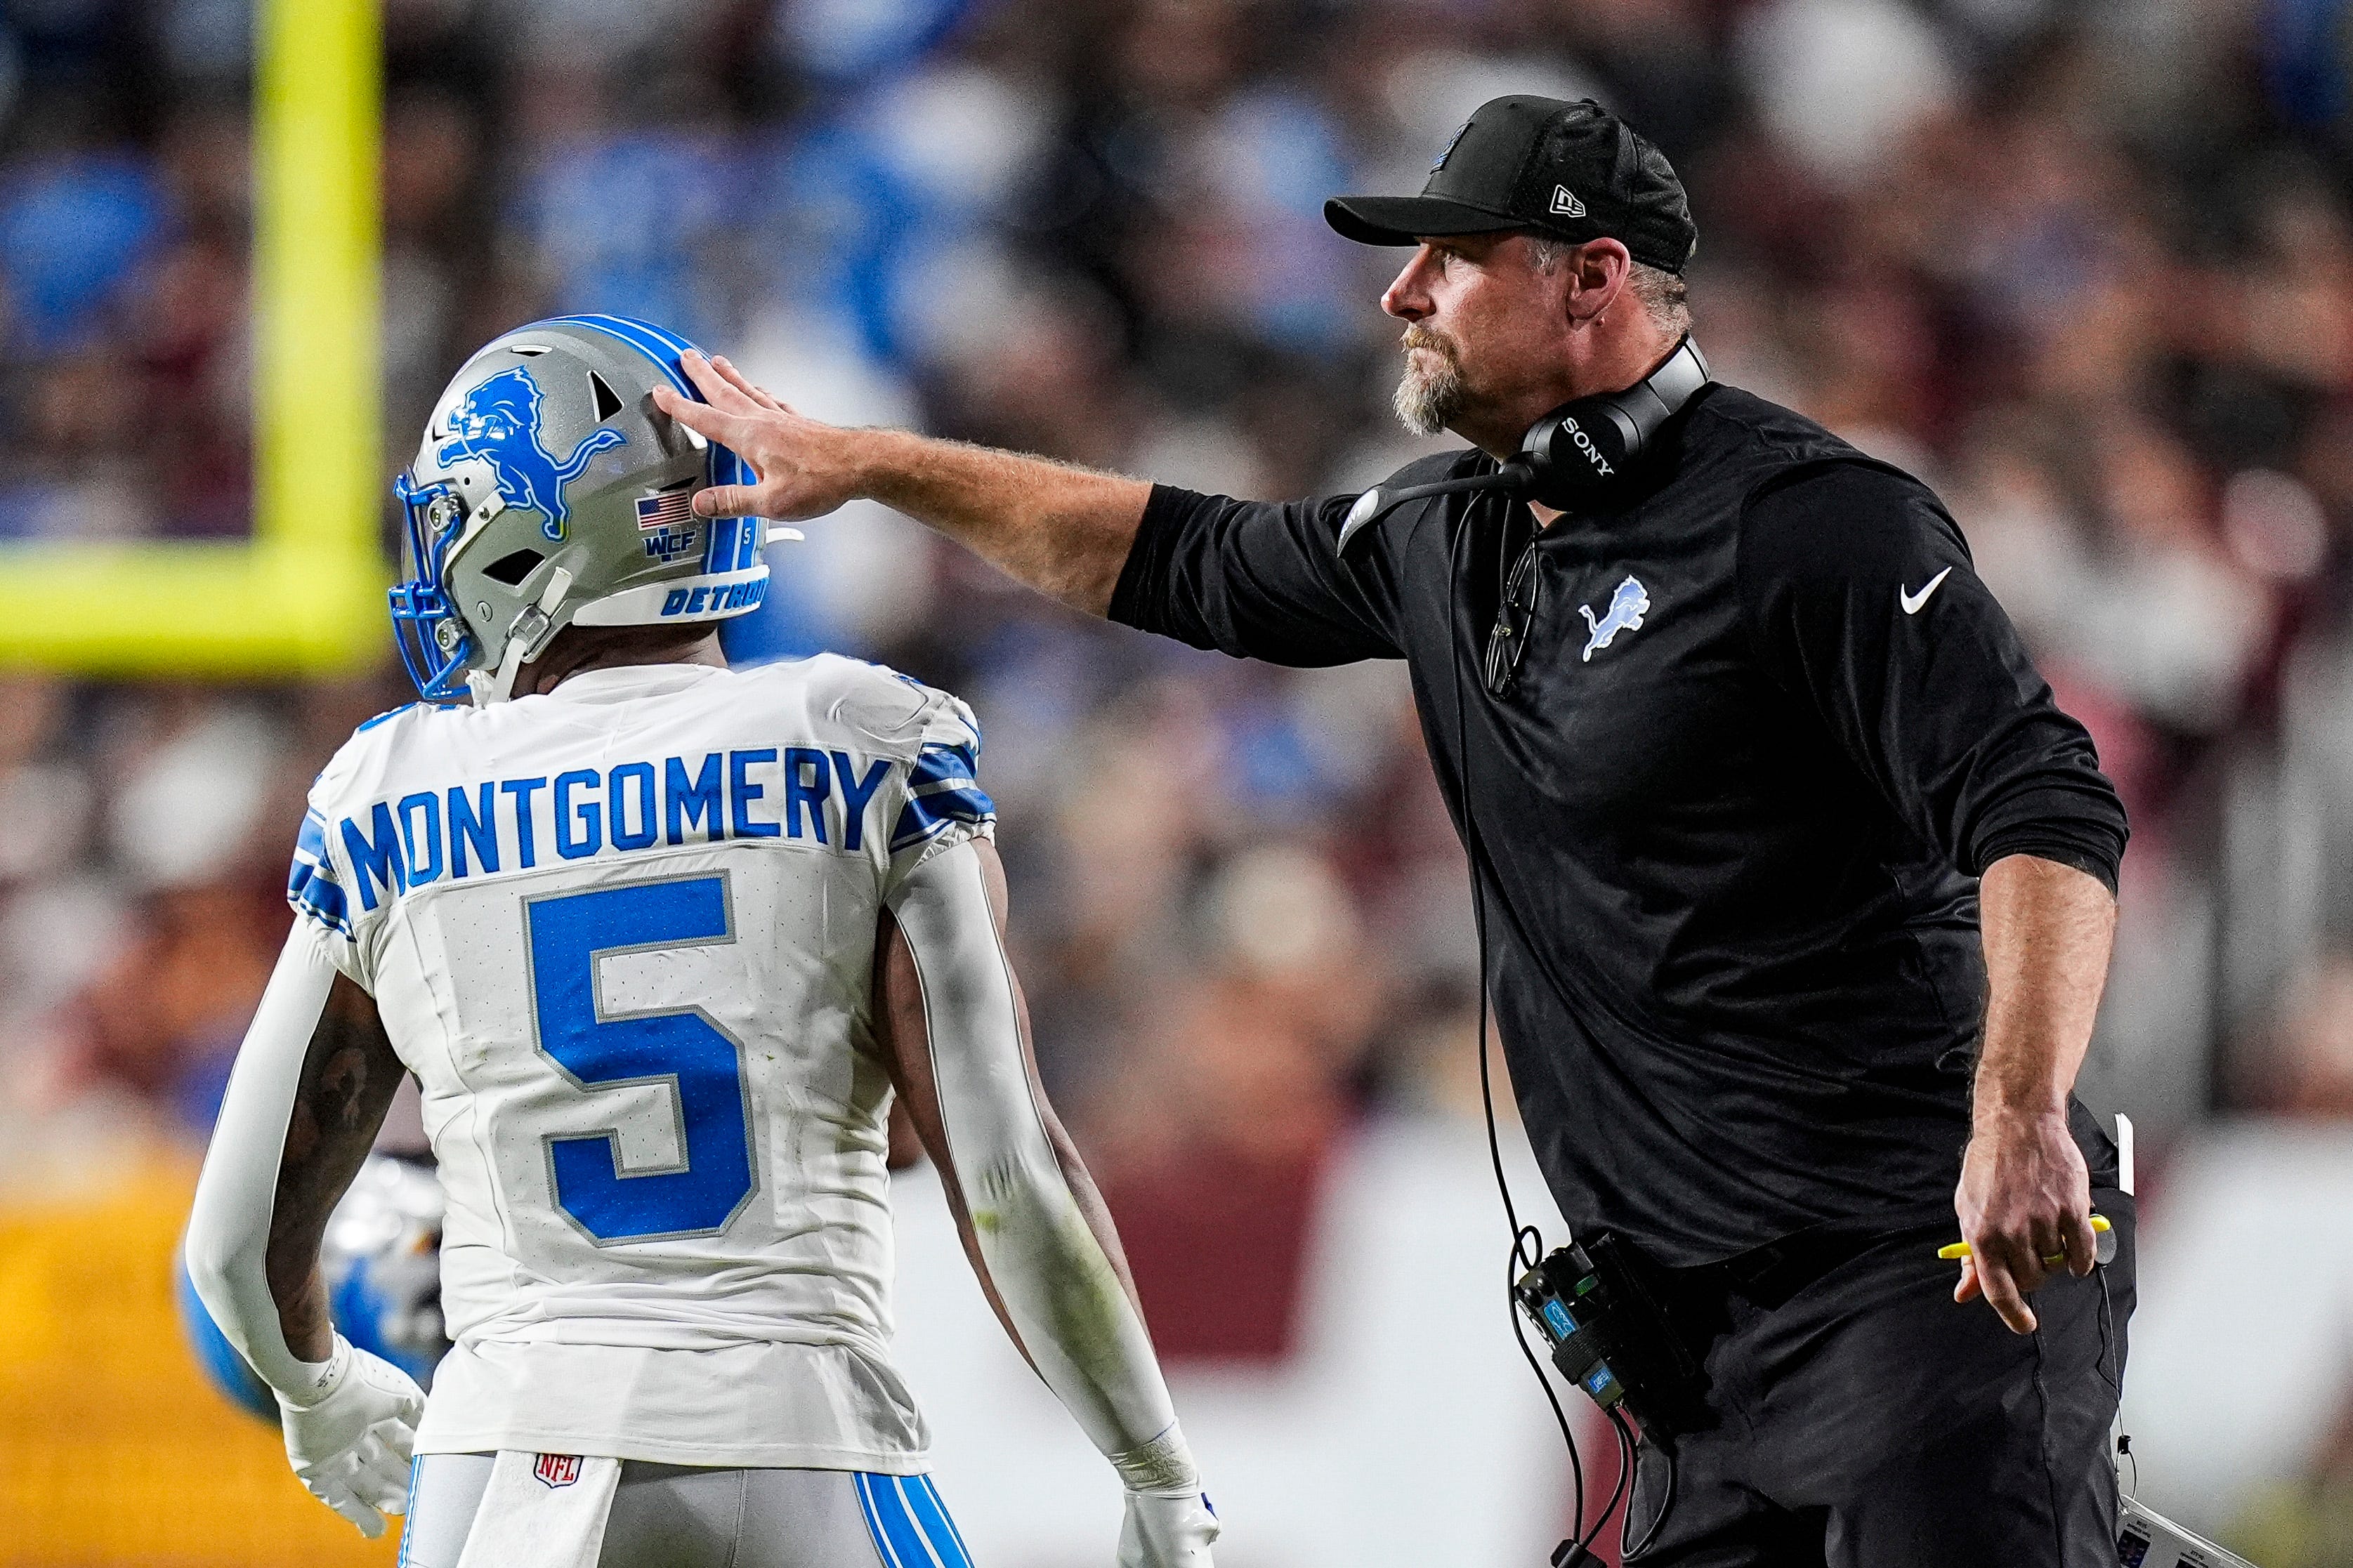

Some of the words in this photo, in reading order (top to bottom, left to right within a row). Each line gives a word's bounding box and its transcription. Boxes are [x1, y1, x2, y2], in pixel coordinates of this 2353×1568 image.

[1561, 417, 1614, 476] SONY
[642, 529, 697, 558] WCF
[743, 527, 751, 544] 5
[340, 746, 893, 911] MONTGOMERY
[520, 868, 760, 1248] 5
[539, 1454, 575, 1482] NFL
